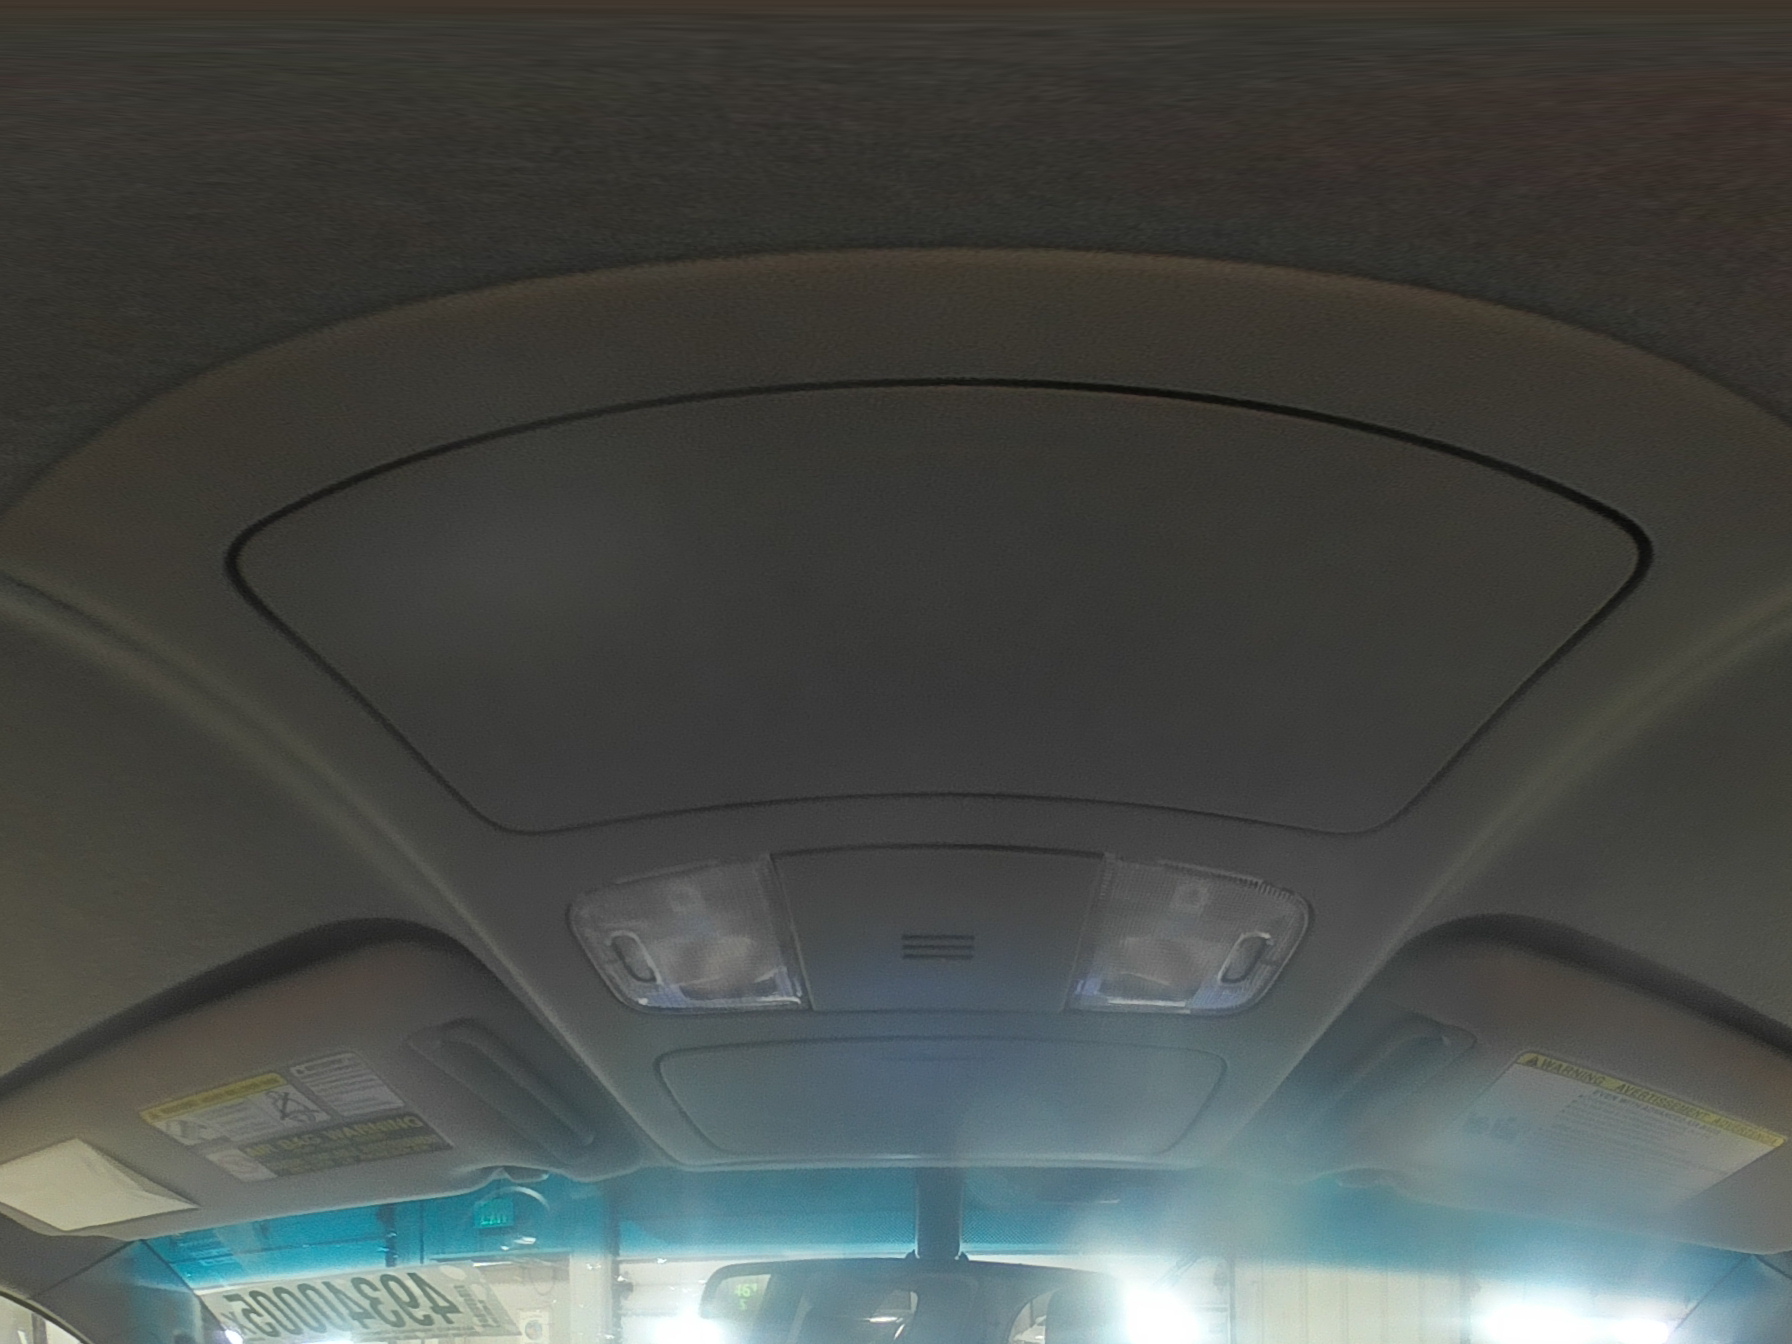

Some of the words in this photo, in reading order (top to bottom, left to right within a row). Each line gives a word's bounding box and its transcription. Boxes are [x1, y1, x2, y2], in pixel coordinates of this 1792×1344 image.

[1540, 1057, 1607, 1086] WARNING
[1615, 1082, 1710, 1120] AVERTISSEMENT
[321, 1114, 425, 1142] WARNING
